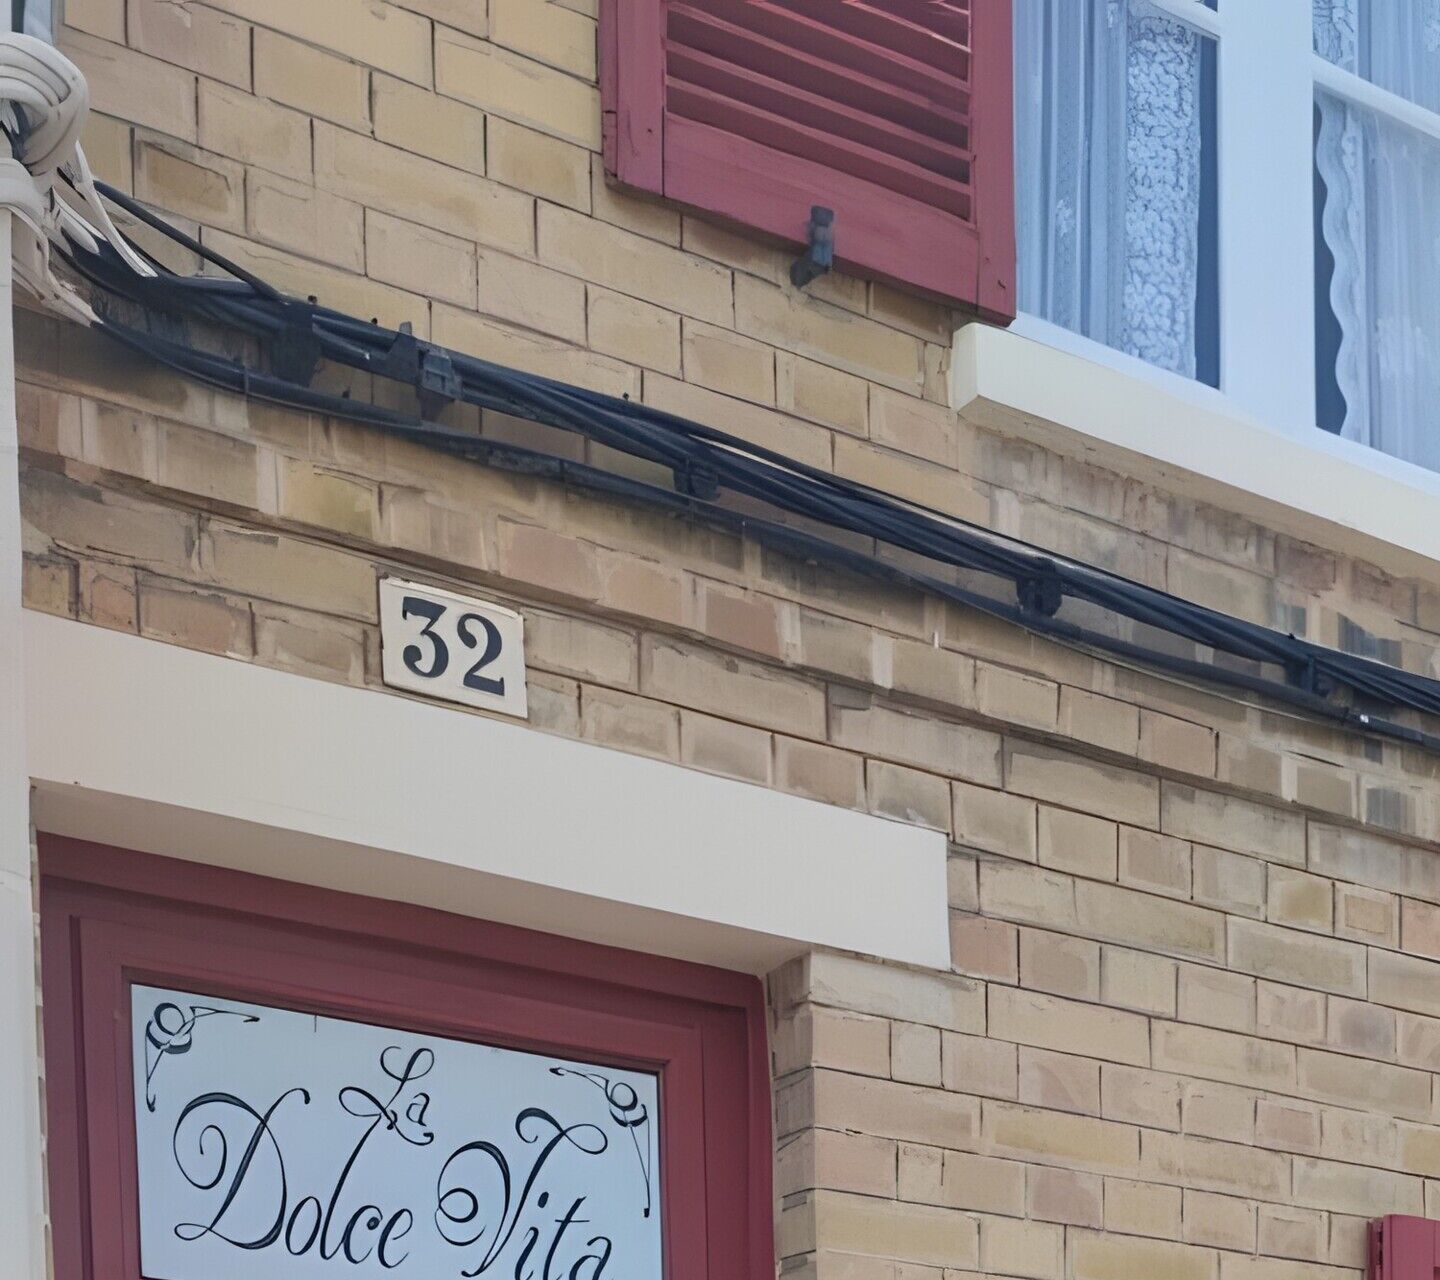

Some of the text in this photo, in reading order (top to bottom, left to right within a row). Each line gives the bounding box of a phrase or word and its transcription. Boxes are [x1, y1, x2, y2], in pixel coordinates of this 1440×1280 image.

[402, 596, 505, 696] 32
[339, 1046, 435, 1146] La
[173, 1087, 414, 1269] Dolce
